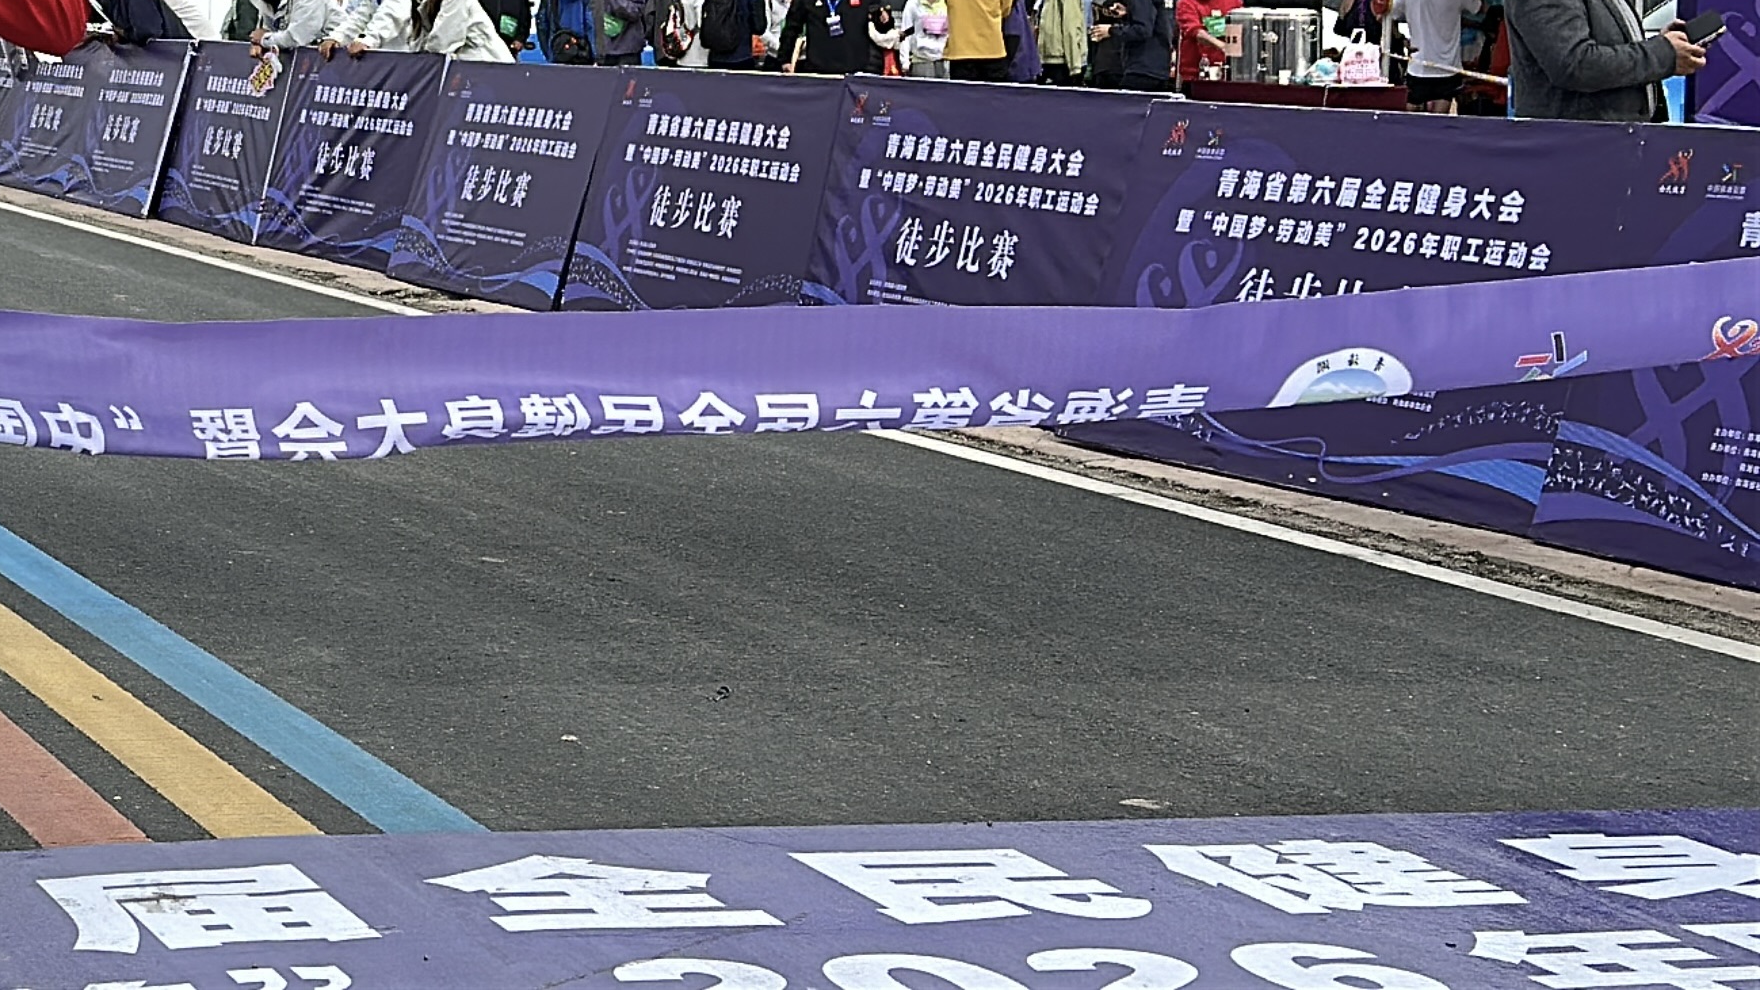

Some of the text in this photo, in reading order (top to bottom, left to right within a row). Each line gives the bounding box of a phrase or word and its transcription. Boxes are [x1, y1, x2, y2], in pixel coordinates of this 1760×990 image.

[885, 133, 1085, 177] 青海省第六届全民健身大会
[460, 164, 532, 208] 徒步比赛
[649, 185, 742, 239] 徒步比赛
[1217, 168, 1525, 223] 青海省第六届全民健身大会
[895, 217, 1019, 280] 徒步比赛
